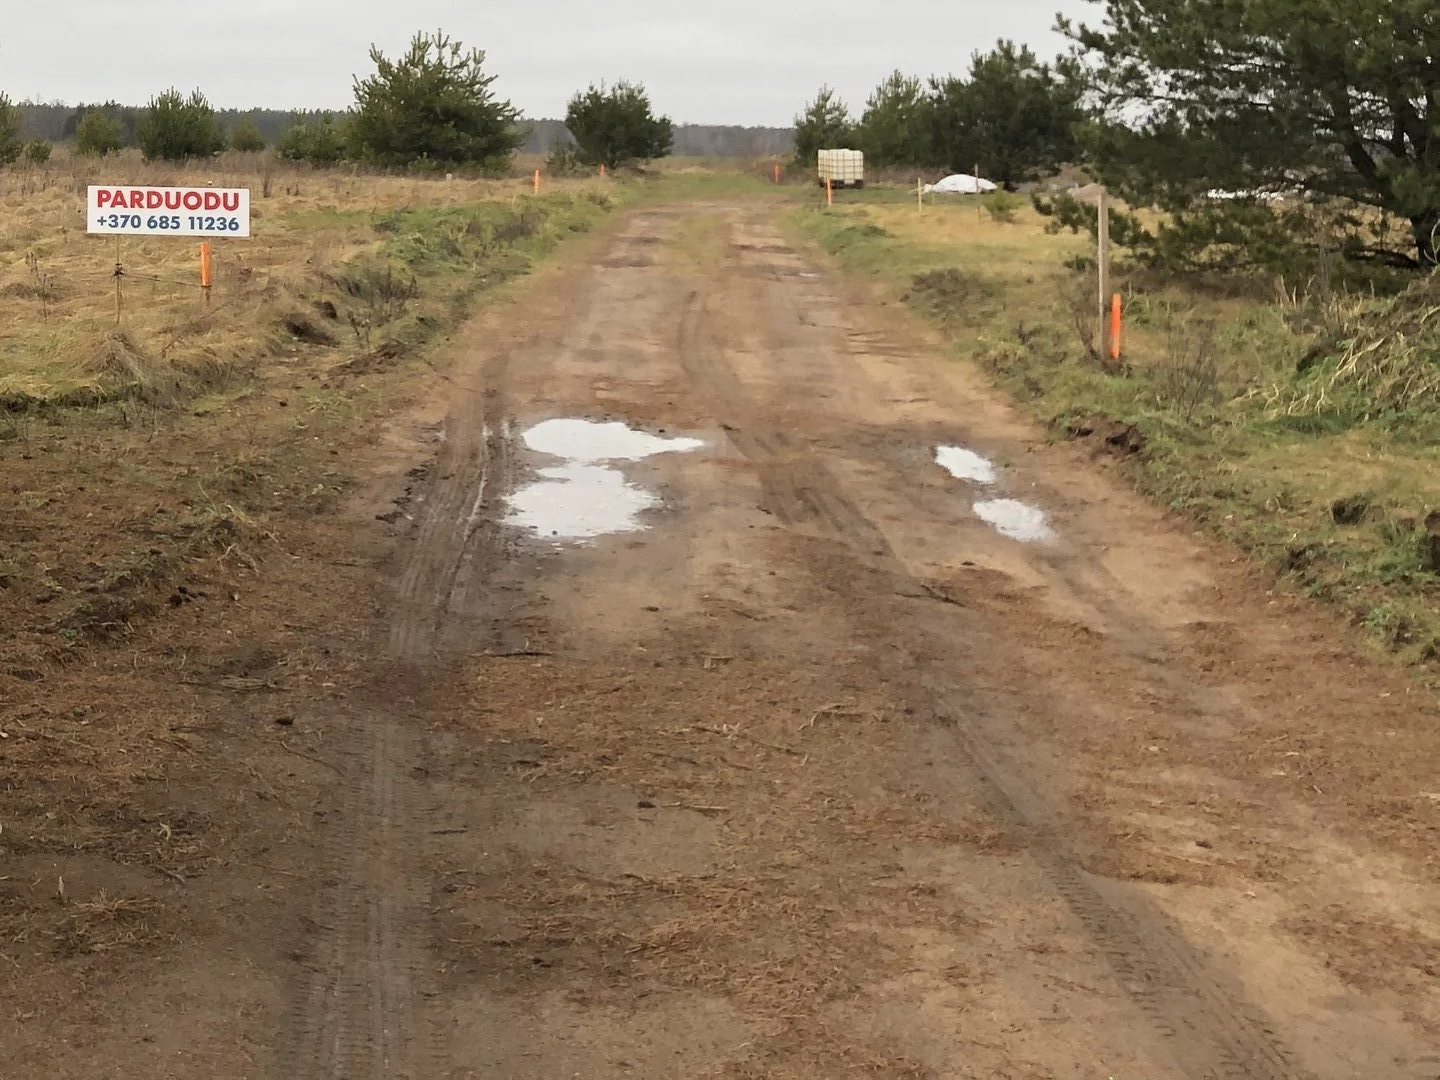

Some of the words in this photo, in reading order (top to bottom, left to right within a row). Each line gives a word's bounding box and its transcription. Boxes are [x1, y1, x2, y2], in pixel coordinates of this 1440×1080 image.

[97, 190, 240, 211] PARDUODU
[97, 214, 141, 229] +370
[147, 215, 181, 230] 685
[188, 216, 240, 231] 11236
